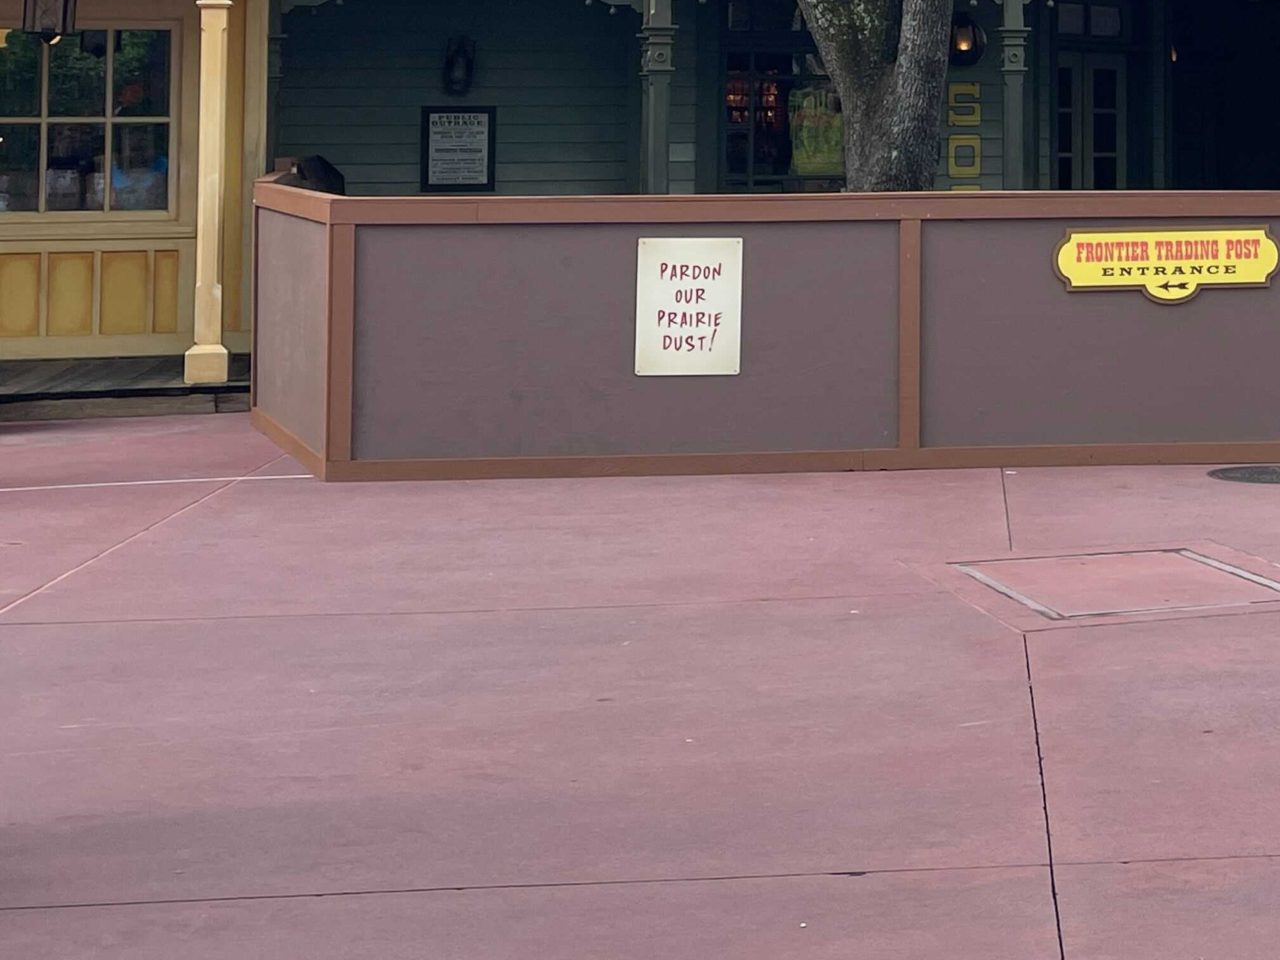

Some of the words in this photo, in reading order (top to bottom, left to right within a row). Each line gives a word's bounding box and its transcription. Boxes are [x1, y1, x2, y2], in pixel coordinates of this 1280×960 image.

[947, 81, 981, 191] SO
[1076, 241, 1149, 263] FRONTIER
[1155, 240, 1219, 261] TRADING
[1226, 239, 1260, 260] POST
[660, 263, 722, 280] PARDON
[1102, 265, 1237, 277] ENTRANCE
[675, 288, 706, 304] OUR
[657, 310, 723, 328] PRAIRIE
[662, 328, 717, 352] DUST!
